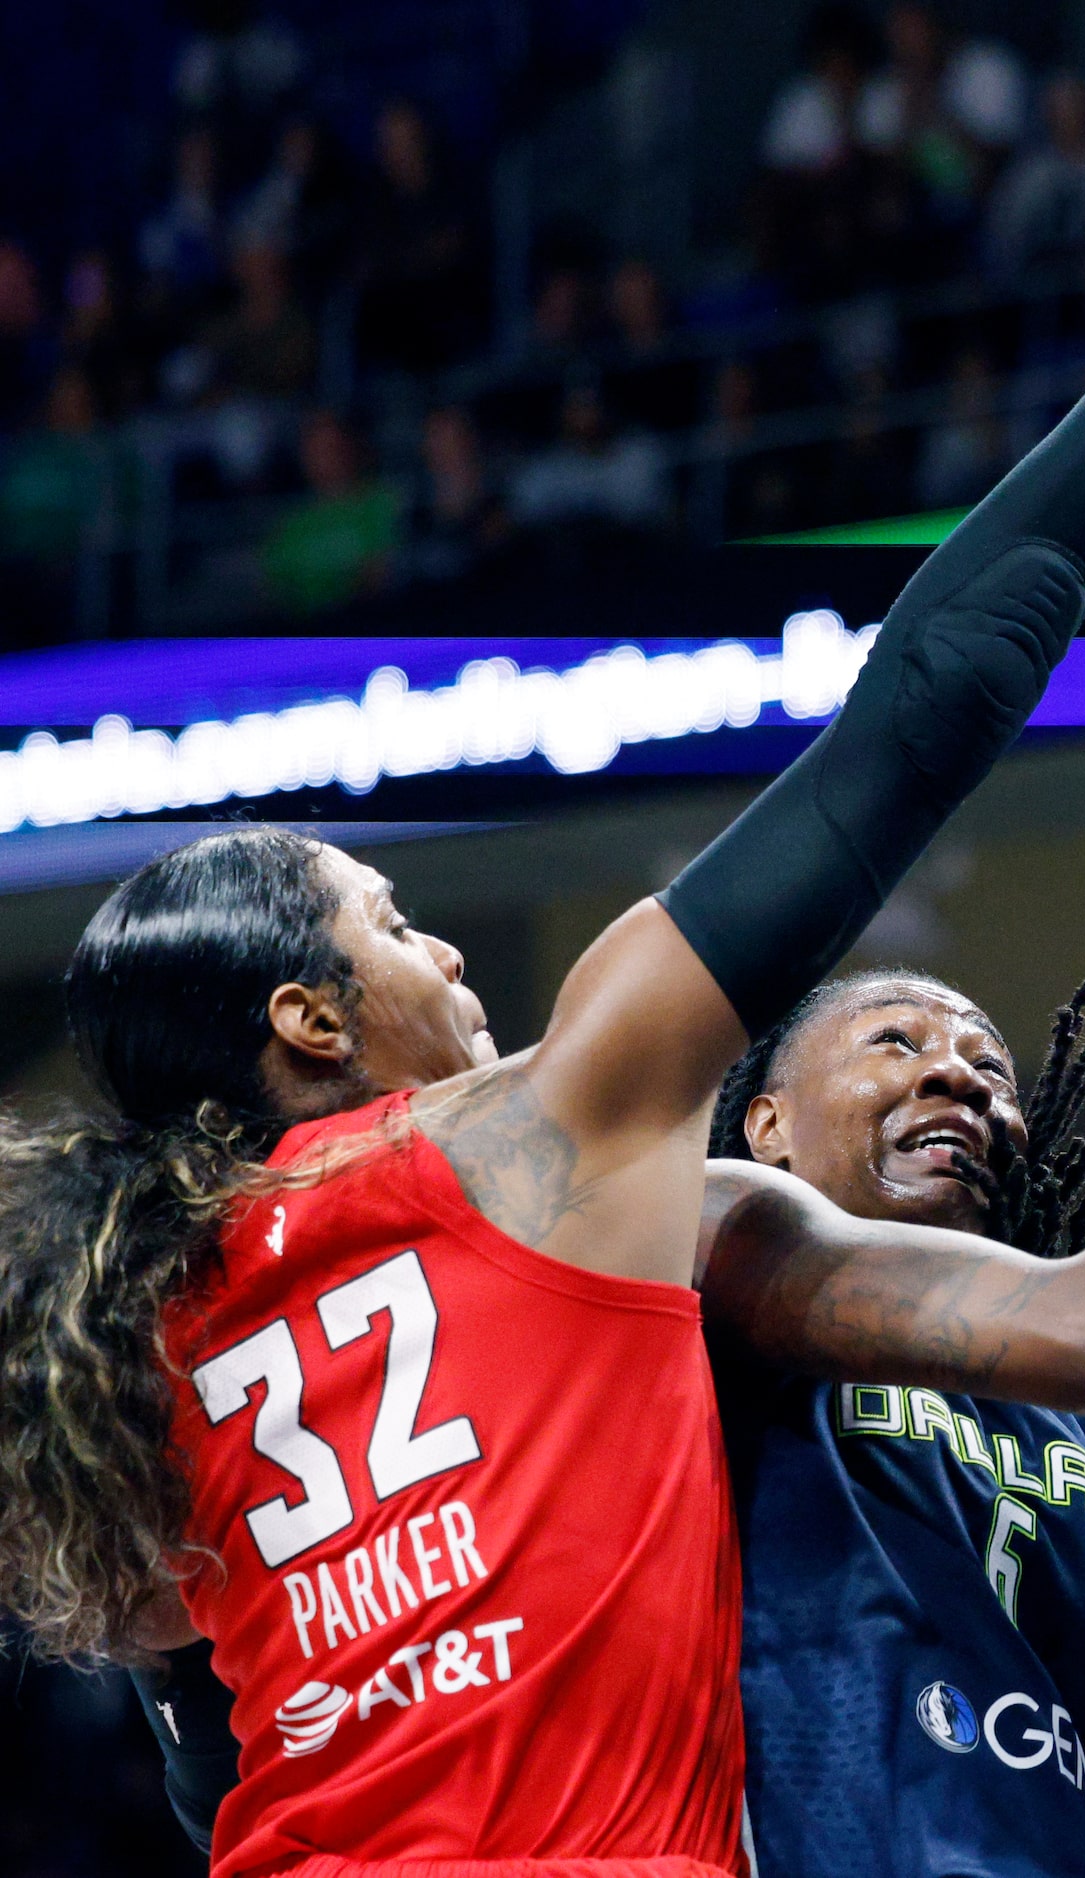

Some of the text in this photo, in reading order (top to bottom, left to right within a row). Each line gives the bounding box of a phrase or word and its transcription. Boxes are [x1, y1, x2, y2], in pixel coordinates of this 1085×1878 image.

[192, 1248, 483, 1569] 32
[283, 1500, 488, 1659] PARKER
[985, 1493, 1037, 1630] 6
[357, 1617, 524, 1721] AT&T
